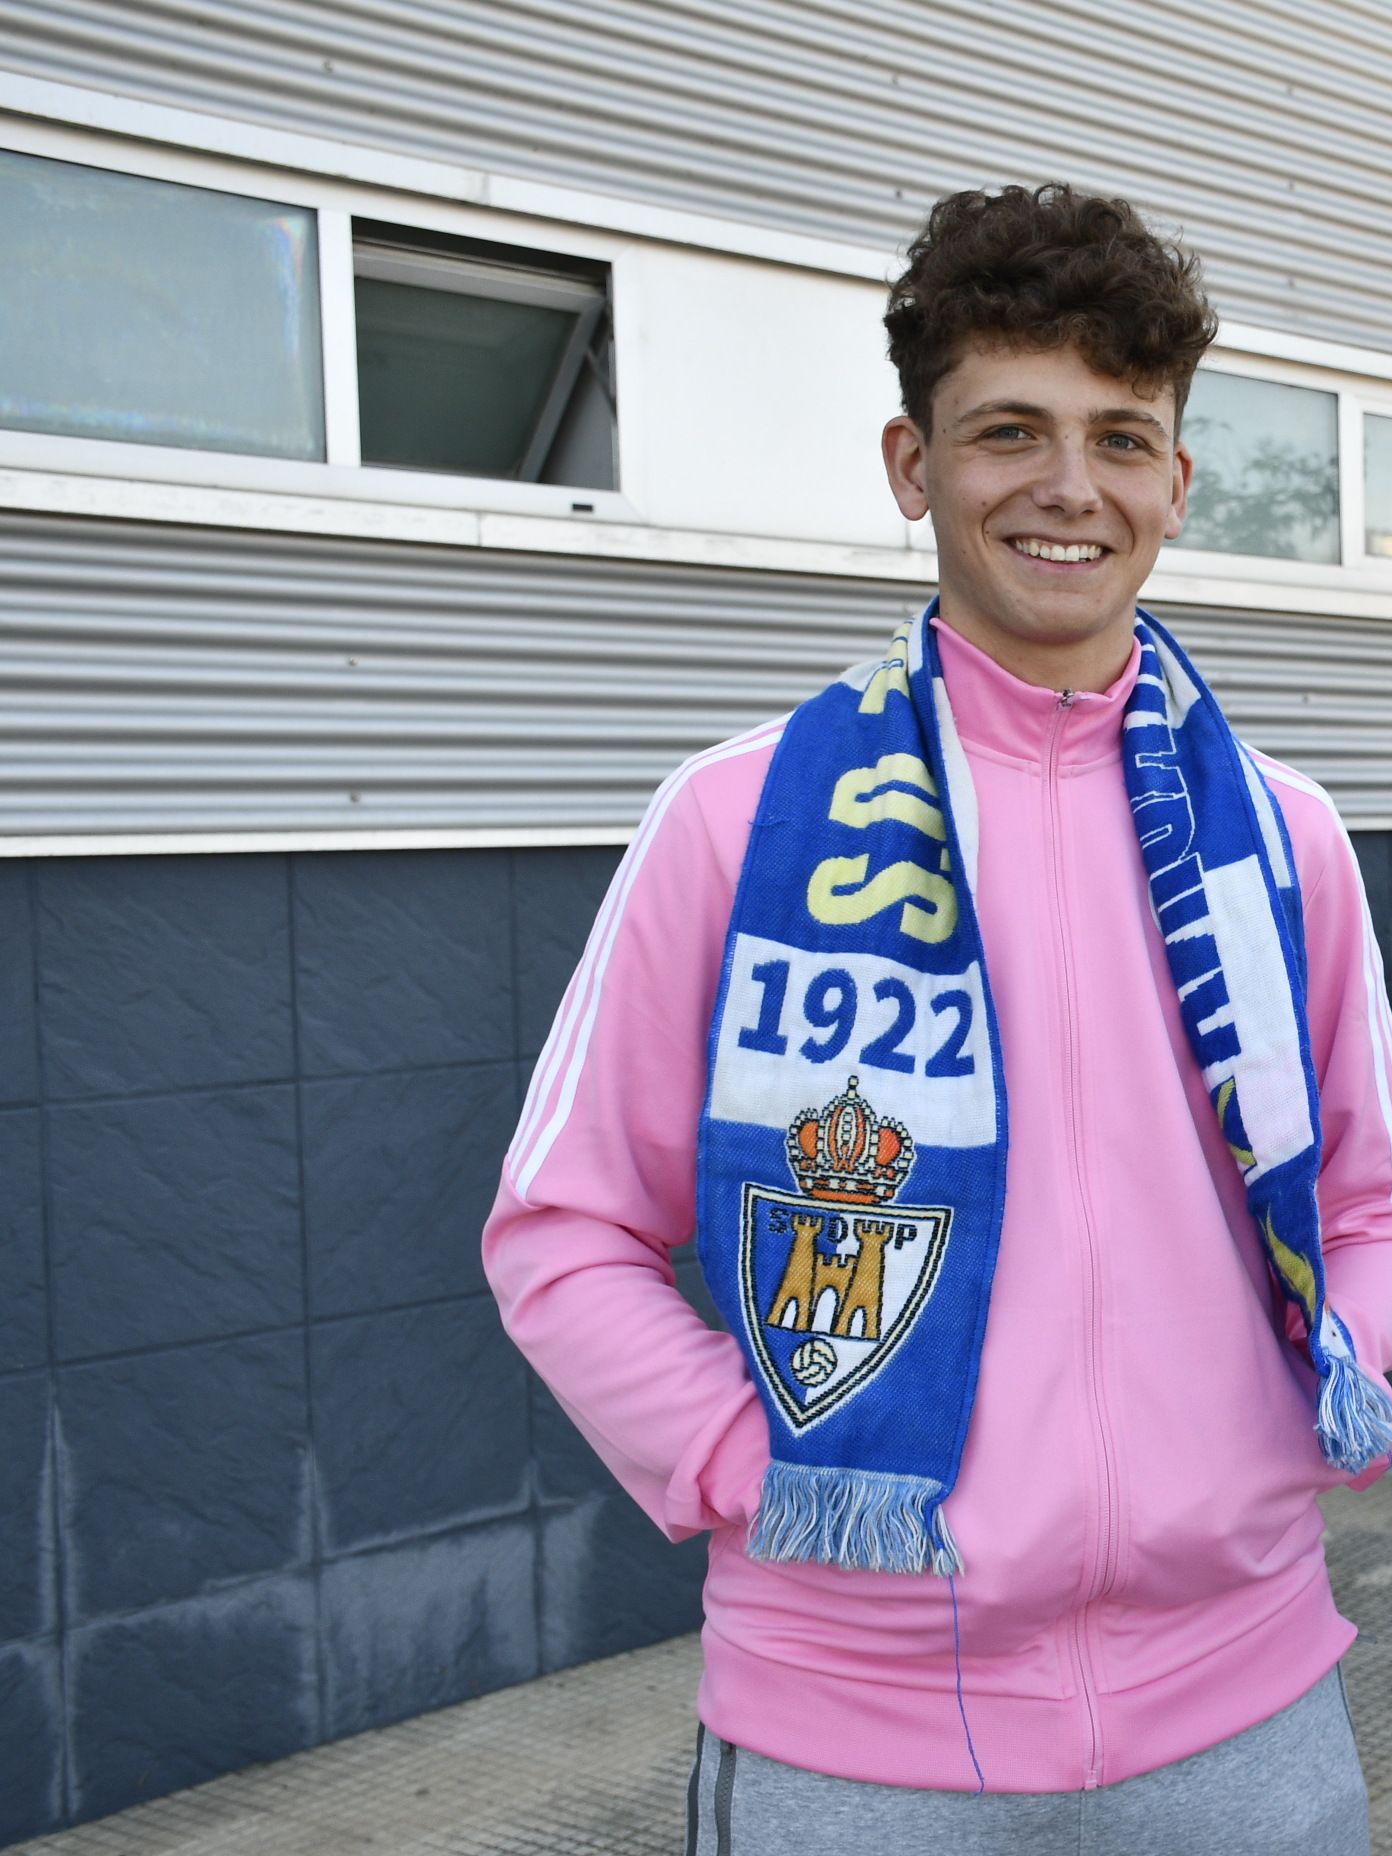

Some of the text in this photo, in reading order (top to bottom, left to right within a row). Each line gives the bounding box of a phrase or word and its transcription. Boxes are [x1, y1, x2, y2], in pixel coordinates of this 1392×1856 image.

[738, 960, 976, 1078] 1922
[768, 1207, 917, 1250] S D P
